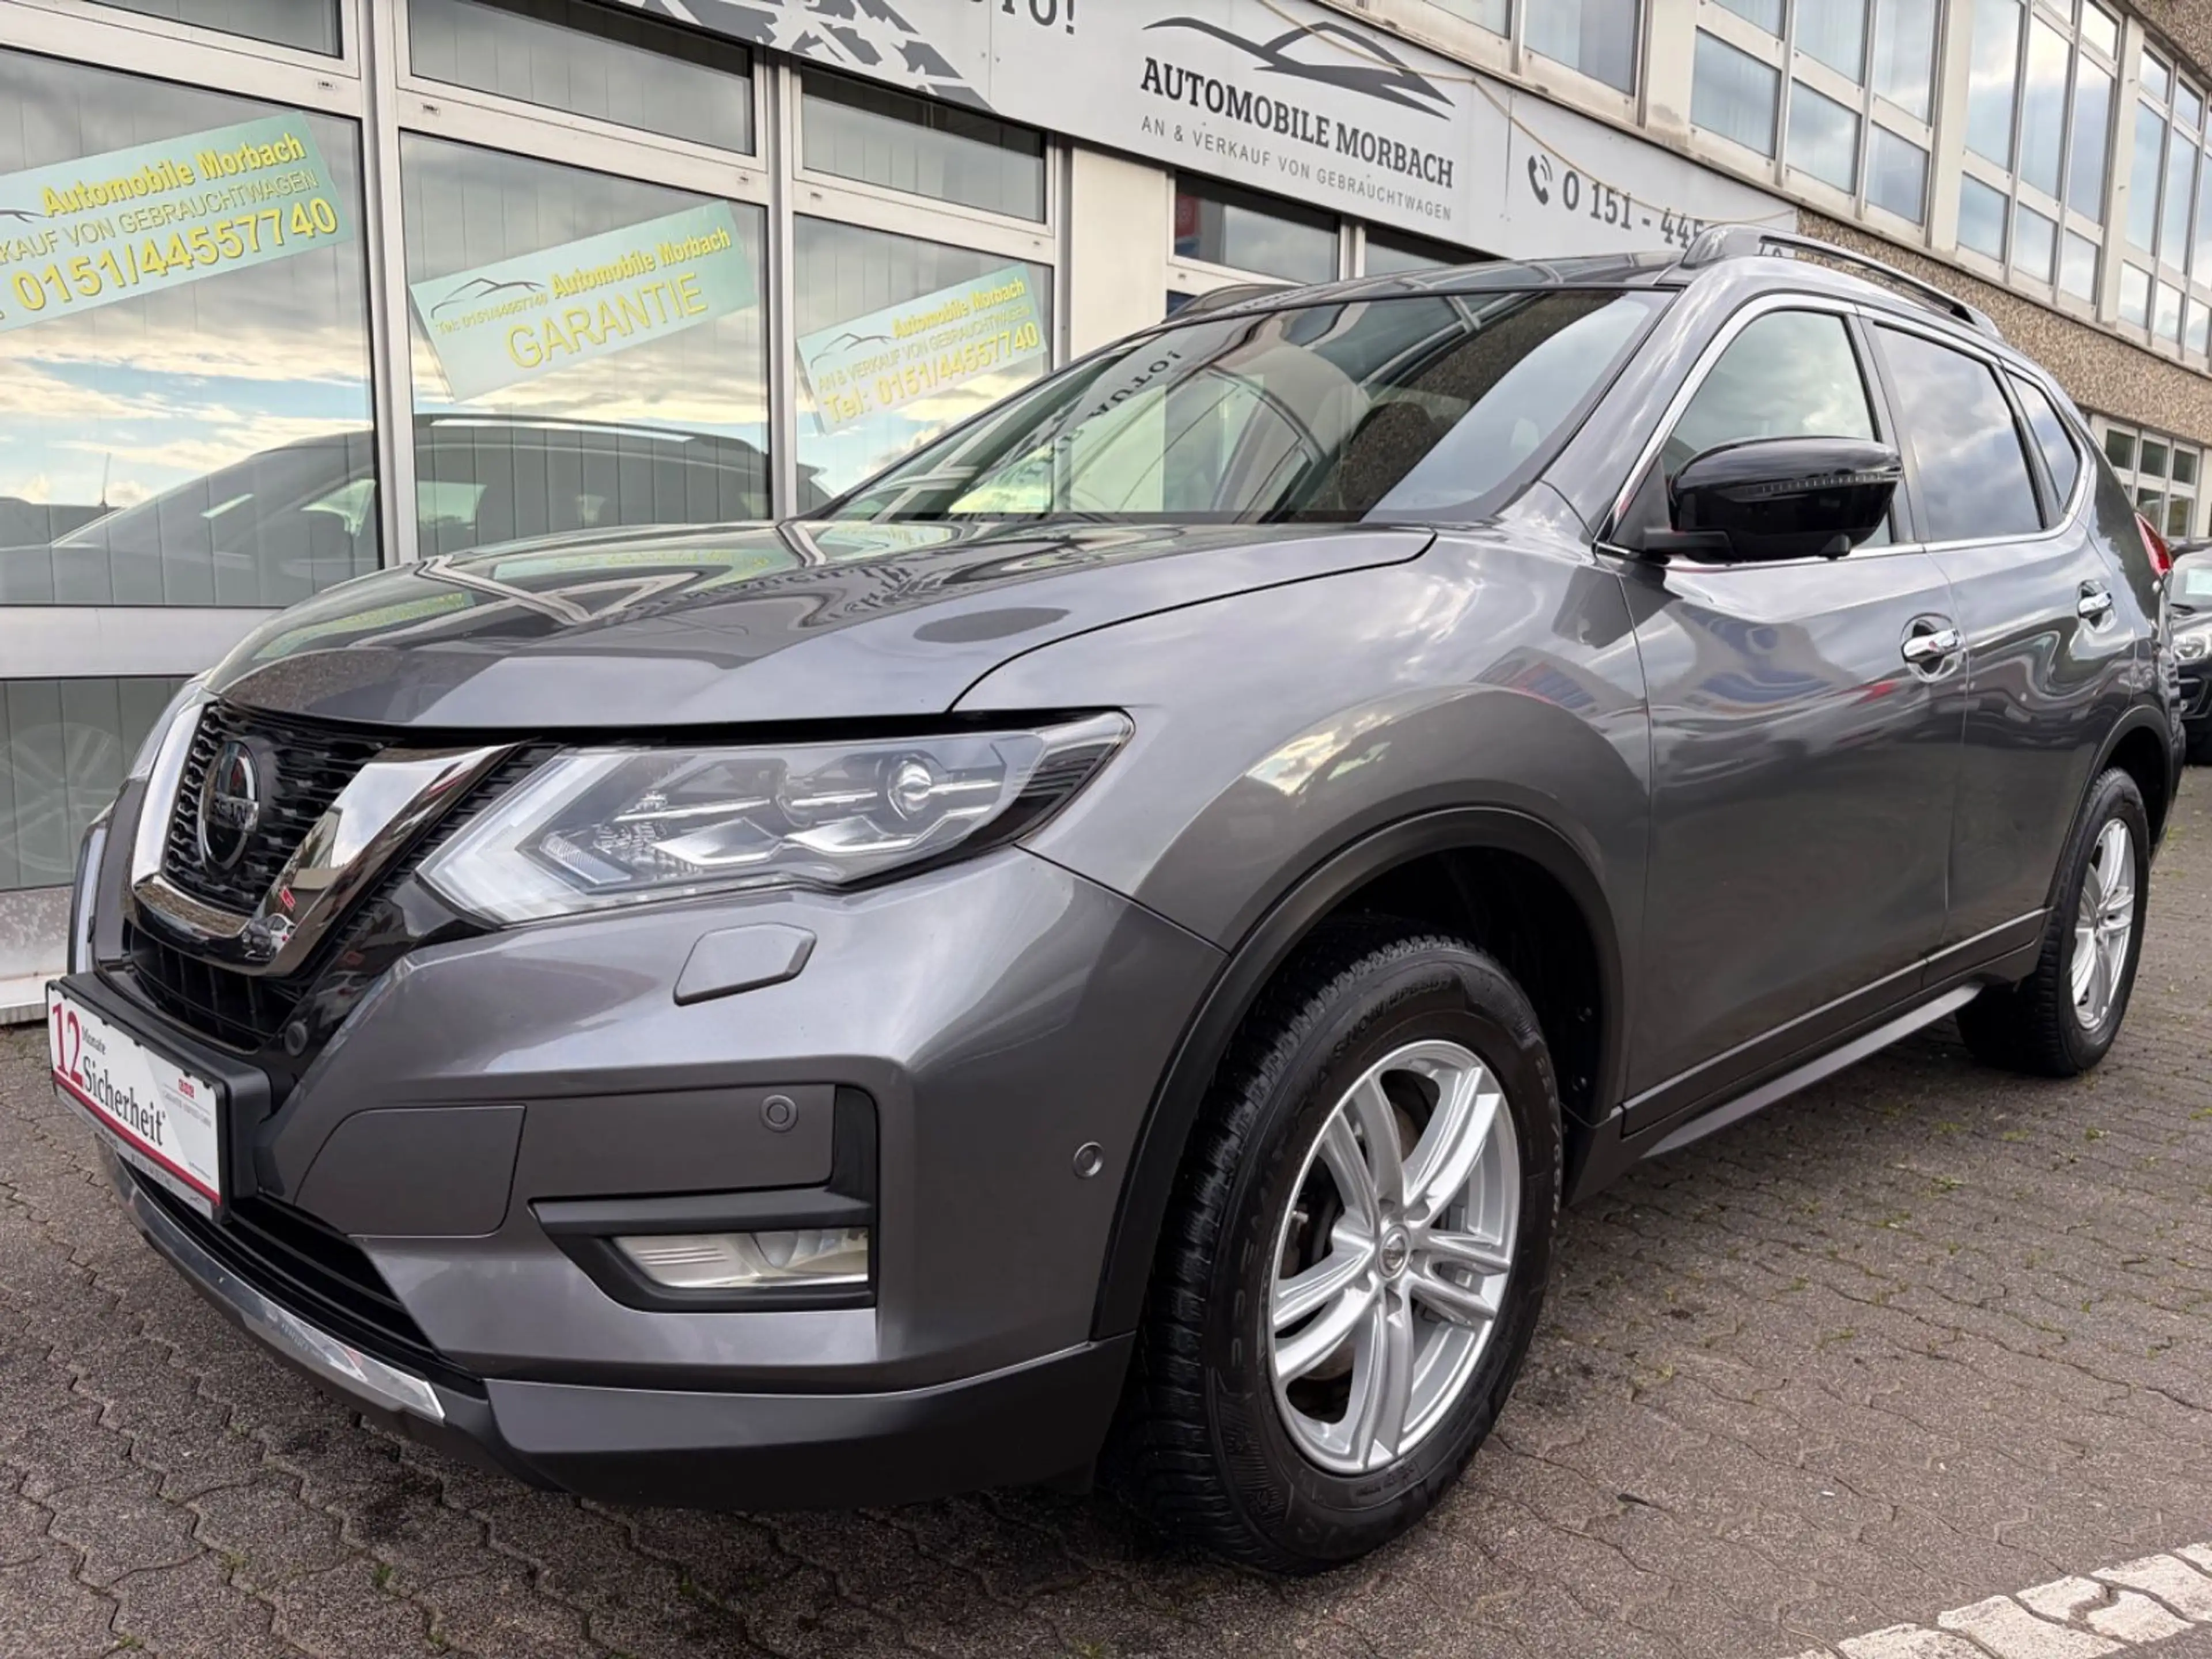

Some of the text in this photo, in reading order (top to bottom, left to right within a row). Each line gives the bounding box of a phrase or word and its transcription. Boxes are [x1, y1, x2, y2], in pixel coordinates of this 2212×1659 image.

[1141, 57, 1454, 188] AUTOMOBILE MORBACH
[1141, 115, 1452, 221] AN & VERKAUF VON GEBRAUCHTWAGEN
[42, 133, 307, 217] Automobile Morbach
[64, 219, 115, 248] VON
[119, 169, 319, 233] GEBRAUCHTWAGEN
[12, 197, 338, 311] 0151/44557740
[551, 226, 732, 299] Automobile Morbach
[507, 272, 709, 369] GARANTIE
[893, 298, 970, 340] Automobile
[823, 321, 1039, 424] Tel: 0151/44557740
[52, 1002, 84, 1088] 12
